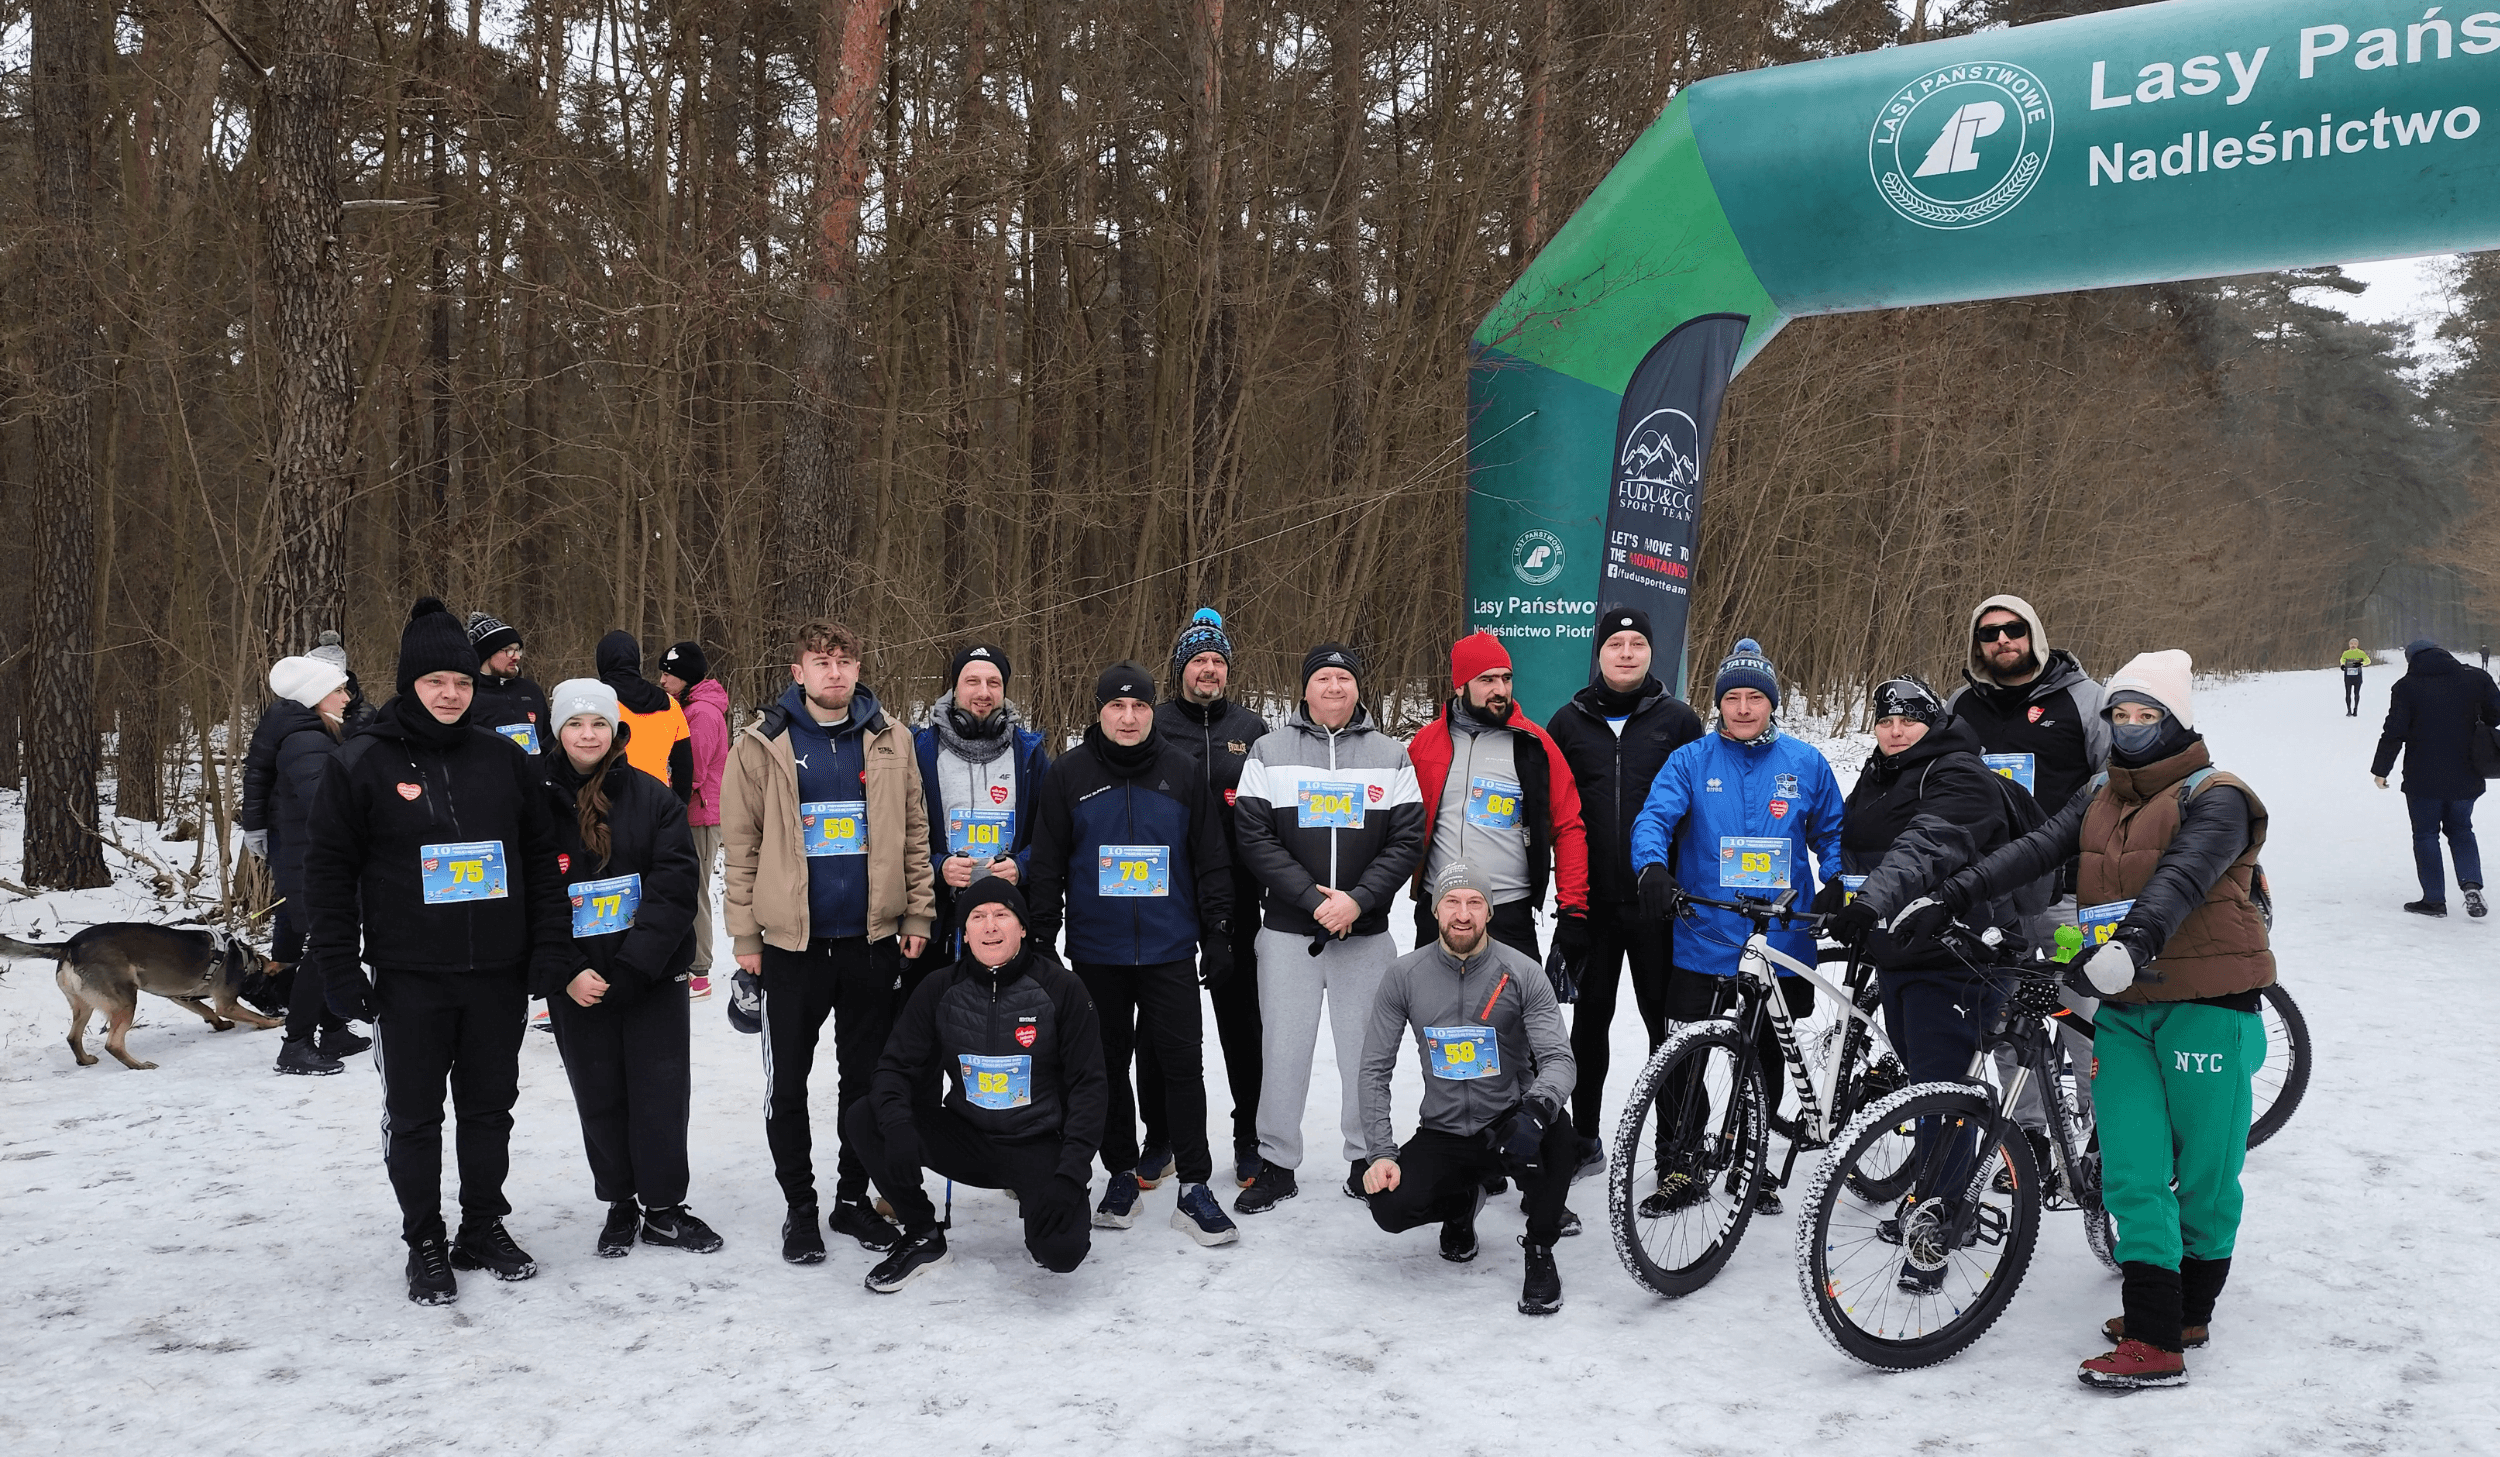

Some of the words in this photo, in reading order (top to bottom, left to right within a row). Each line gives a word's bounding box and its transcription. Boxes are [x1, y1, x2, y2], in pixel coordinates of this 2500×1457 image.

[2089, 46, 2270, 111] Lasy
[2299, 6, 2500, 80] Pańs
[1877, 90, 1916, 144] LASY
[1919, 66, 2046, 125] PAŃSTWOWE
[2088, 104, 2482, 187] Nadleśnictwo
[1620, 499, 1656, 513] SPORT
[1514, 539, 1526, 557] LASY
[1610, 547, 1627, 563] THE
[1611, 530, 1639, 548] LET'S
[1644, 538, 1673, 557] MOVE
[1680, 546, 1690, 562] TO
[1474, 597, 1504, 618] Lasy
[1508, 596, 1598, 615] Państwo
[1726, 659, 1764, 670] TATRY
[1120, 684, 1133, 692] 4F
[2040, 720, 2055, 728] 4F
[1309, 795, 1353, 814] 204
[1486, 794, 1517, 816] 86
[823, 818, 856, 840] 59
[967, 824, 1000, 844] 161
[432, 847, 450, 856] 10
[1108, 847, 1123, 855] 10
[449, 860, 484, 884] 75
[1119, 861, 1149, 881] 78
[1741, 852, 1772, 873] 53
[577, 884, 593, 893] 10
[592, 895, 622, 918] 77
[2084, 910, 2094, 920] 10
[1443, 1041, 1476, 1065] 58
[2173, 1050, 2224, 1074] NYC
[977, 1072, 1010, 1094] 52
[1758, 1093, 1767, 1148] MEZCAL
[2047, 1058, 2080, 1169] ROCKRIDER
[1963, 1154, 1995, 1205] ROCKSHOX
